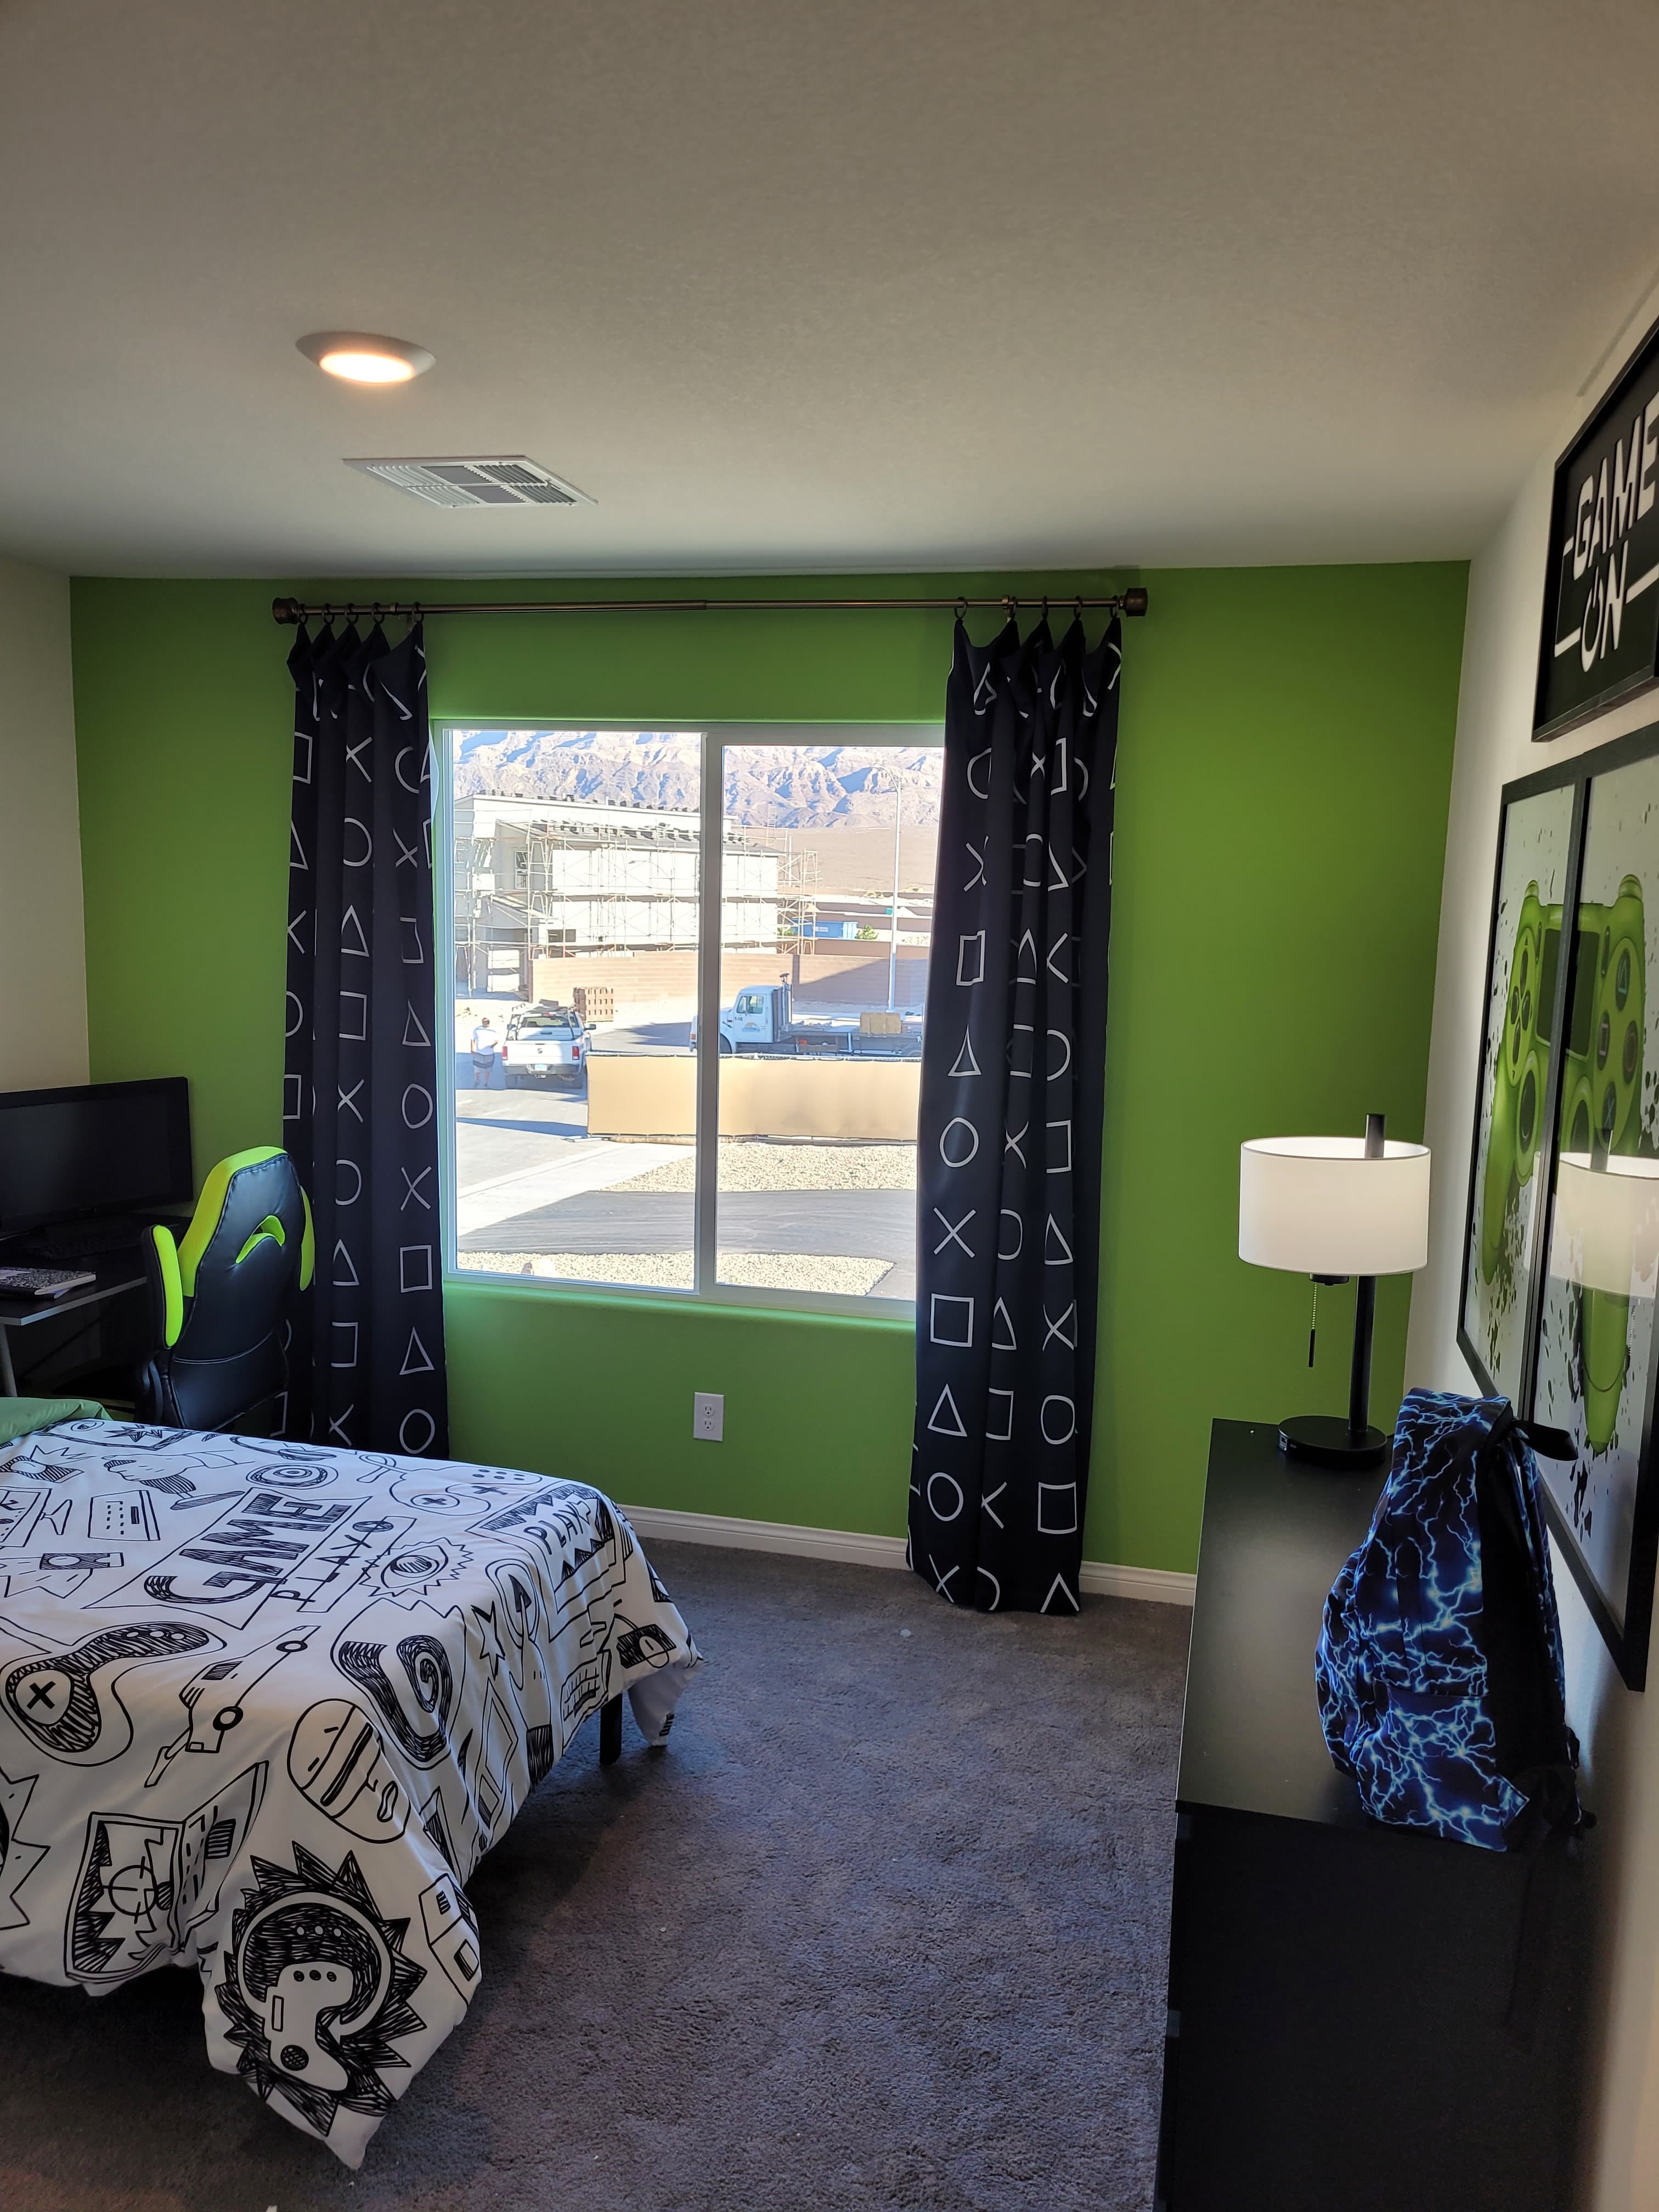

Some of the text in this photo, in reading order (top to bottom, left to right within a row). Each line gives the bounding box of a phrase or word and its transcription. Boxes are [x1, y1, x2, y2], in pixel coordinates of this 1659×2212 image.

[1573, 391, 1659, 580] GAME
[1580, 539, 1628, 673] ON
[144, 1493, 352, 1604] GAME
[523, 1500, 591, 1555] PLAY
